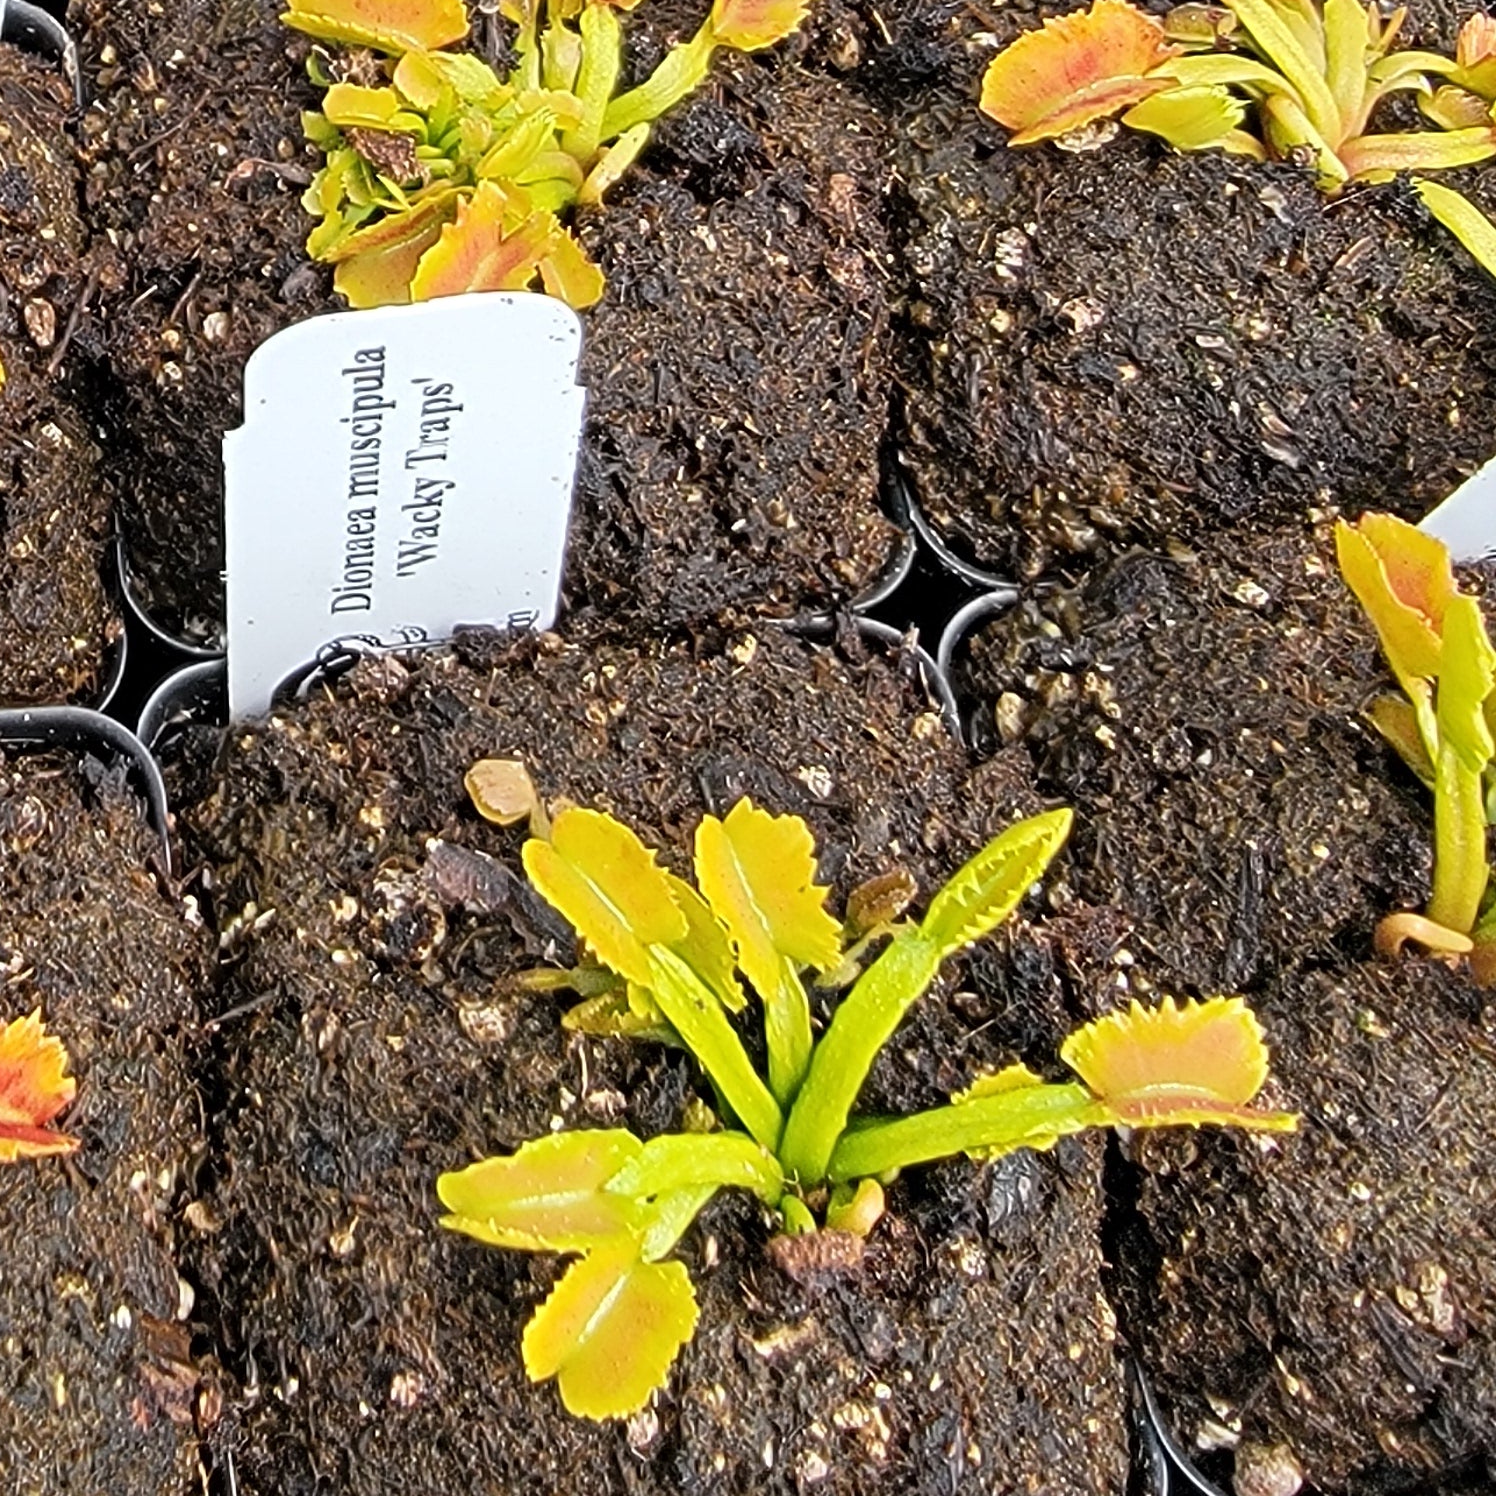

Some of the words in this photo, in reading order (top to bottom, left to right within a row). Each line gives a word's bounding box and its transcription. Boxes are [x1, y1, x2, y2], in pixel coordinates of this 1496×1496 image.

[340, 345, 396, 500] muscipula
[405, 378, 464, 470] Traps'
[331, 506, 377, 615] Dionaea
[396, 476, 455, 577] 'Wacky
